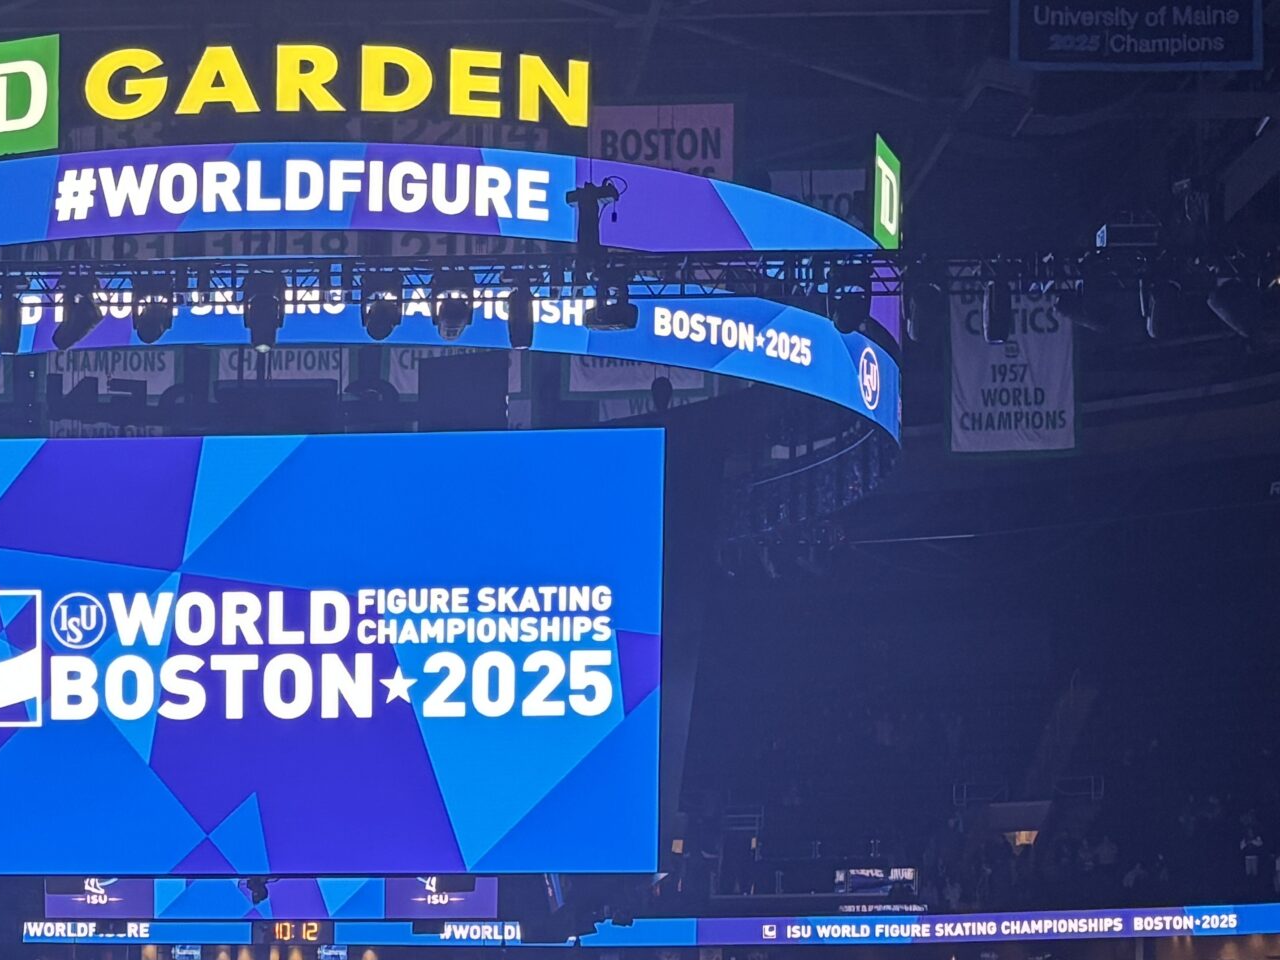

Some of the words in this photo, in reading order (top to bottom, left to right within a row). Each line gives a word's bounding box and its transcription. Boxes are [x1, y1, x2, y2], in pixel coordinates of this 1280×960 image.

[1033, 4, 1136, 31] University
[1145, 4, 1166, 26] of
[1173, 7, 1240, 26] Maine
[1109, 33, 1225, 54] Champions
[84, 43, 589, 127] GARDEN
[601, 127, 721, 160] BOSTON
[55, 159, 549, 222] #WORLDFIGURE
[55, 350, 166, 372] CHAMPIONS
[990, 363, 1028, 383] 1957
[981, 388, 1044, 409] WORLD
[959, 410, 1066, 431] CHAMPIONS
[358, 587, 470, 614] FIGURE
[477, 585, 612, 613] SKATING
[108, 590, 351, 646] WORLD
[357, 616, 612, 645] CHAMPIONSHIPS
[50, 652, 373, 720] BOSTON
[422, 650, 613, 718] 2025
[427, 894, 449, 905] ISU
[786, 925, 812, 939] ISU
[816, 924, 870, 938] WORLD
[875, 922, 931, 938] FIGURE
[935, 922, 997, 937] SKATING
[1001, 918, 1123, 935] CHAMPIONSHIPS
